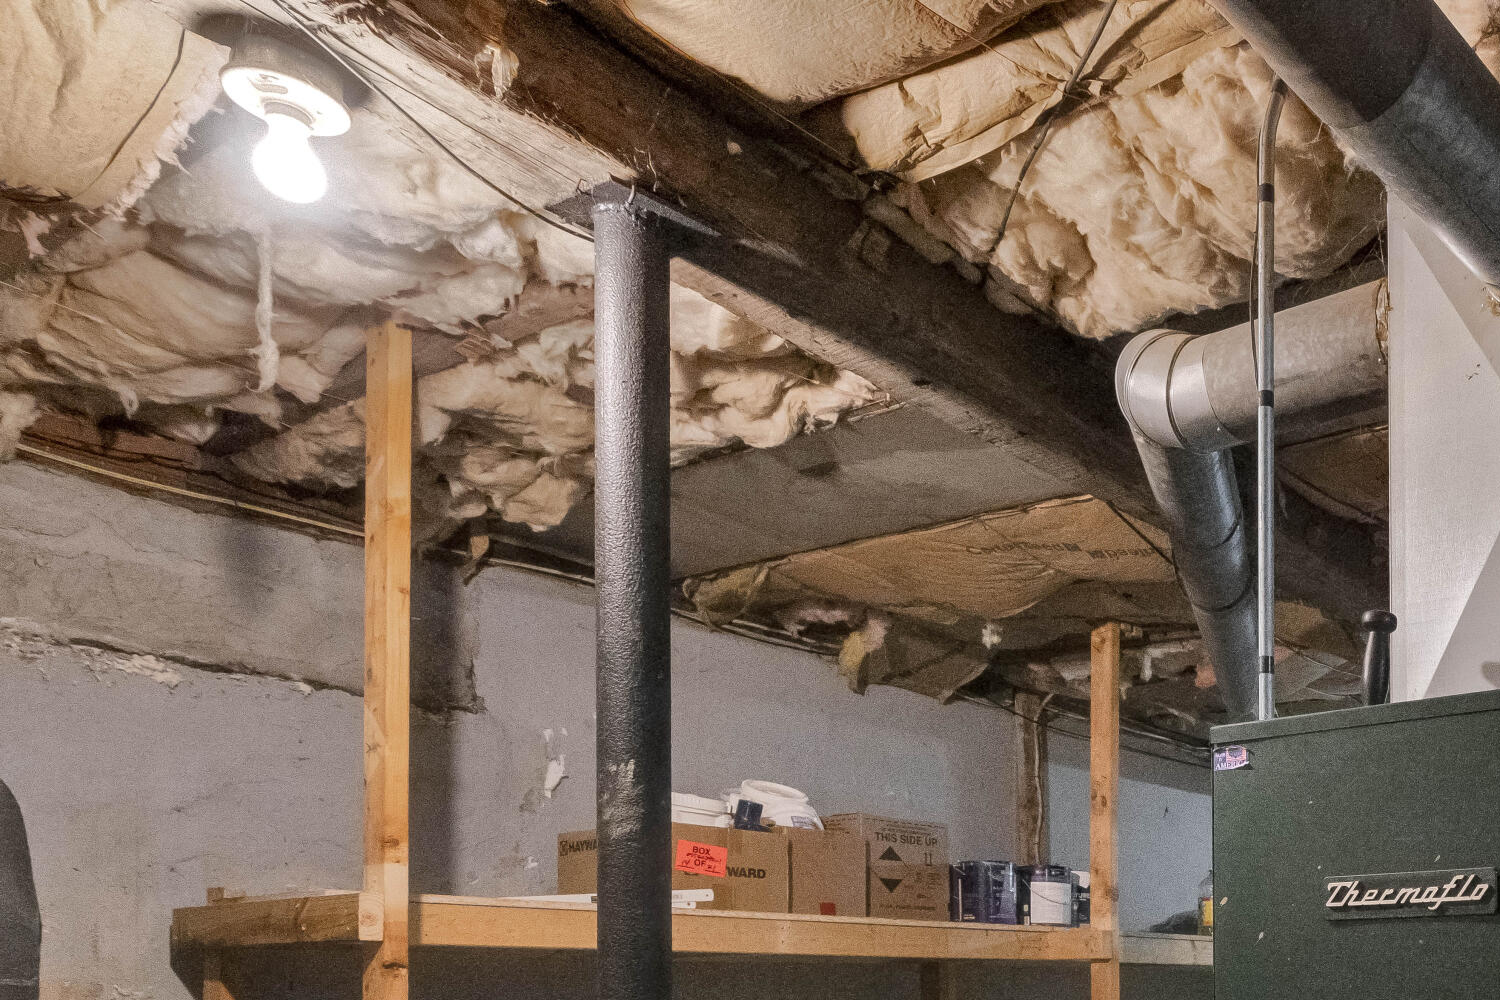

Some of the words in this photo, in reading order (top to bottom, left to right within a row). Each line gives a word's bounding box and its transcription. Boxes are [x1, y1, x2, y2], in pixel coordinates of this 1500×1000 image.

[874, 831, 897, 843] THIS
[900, 834, 923, 846] SIDE
[925, 836, 937, 847] UP
[692, 846, 711, 856] BOX
[693, 859, 706, 867] OF
